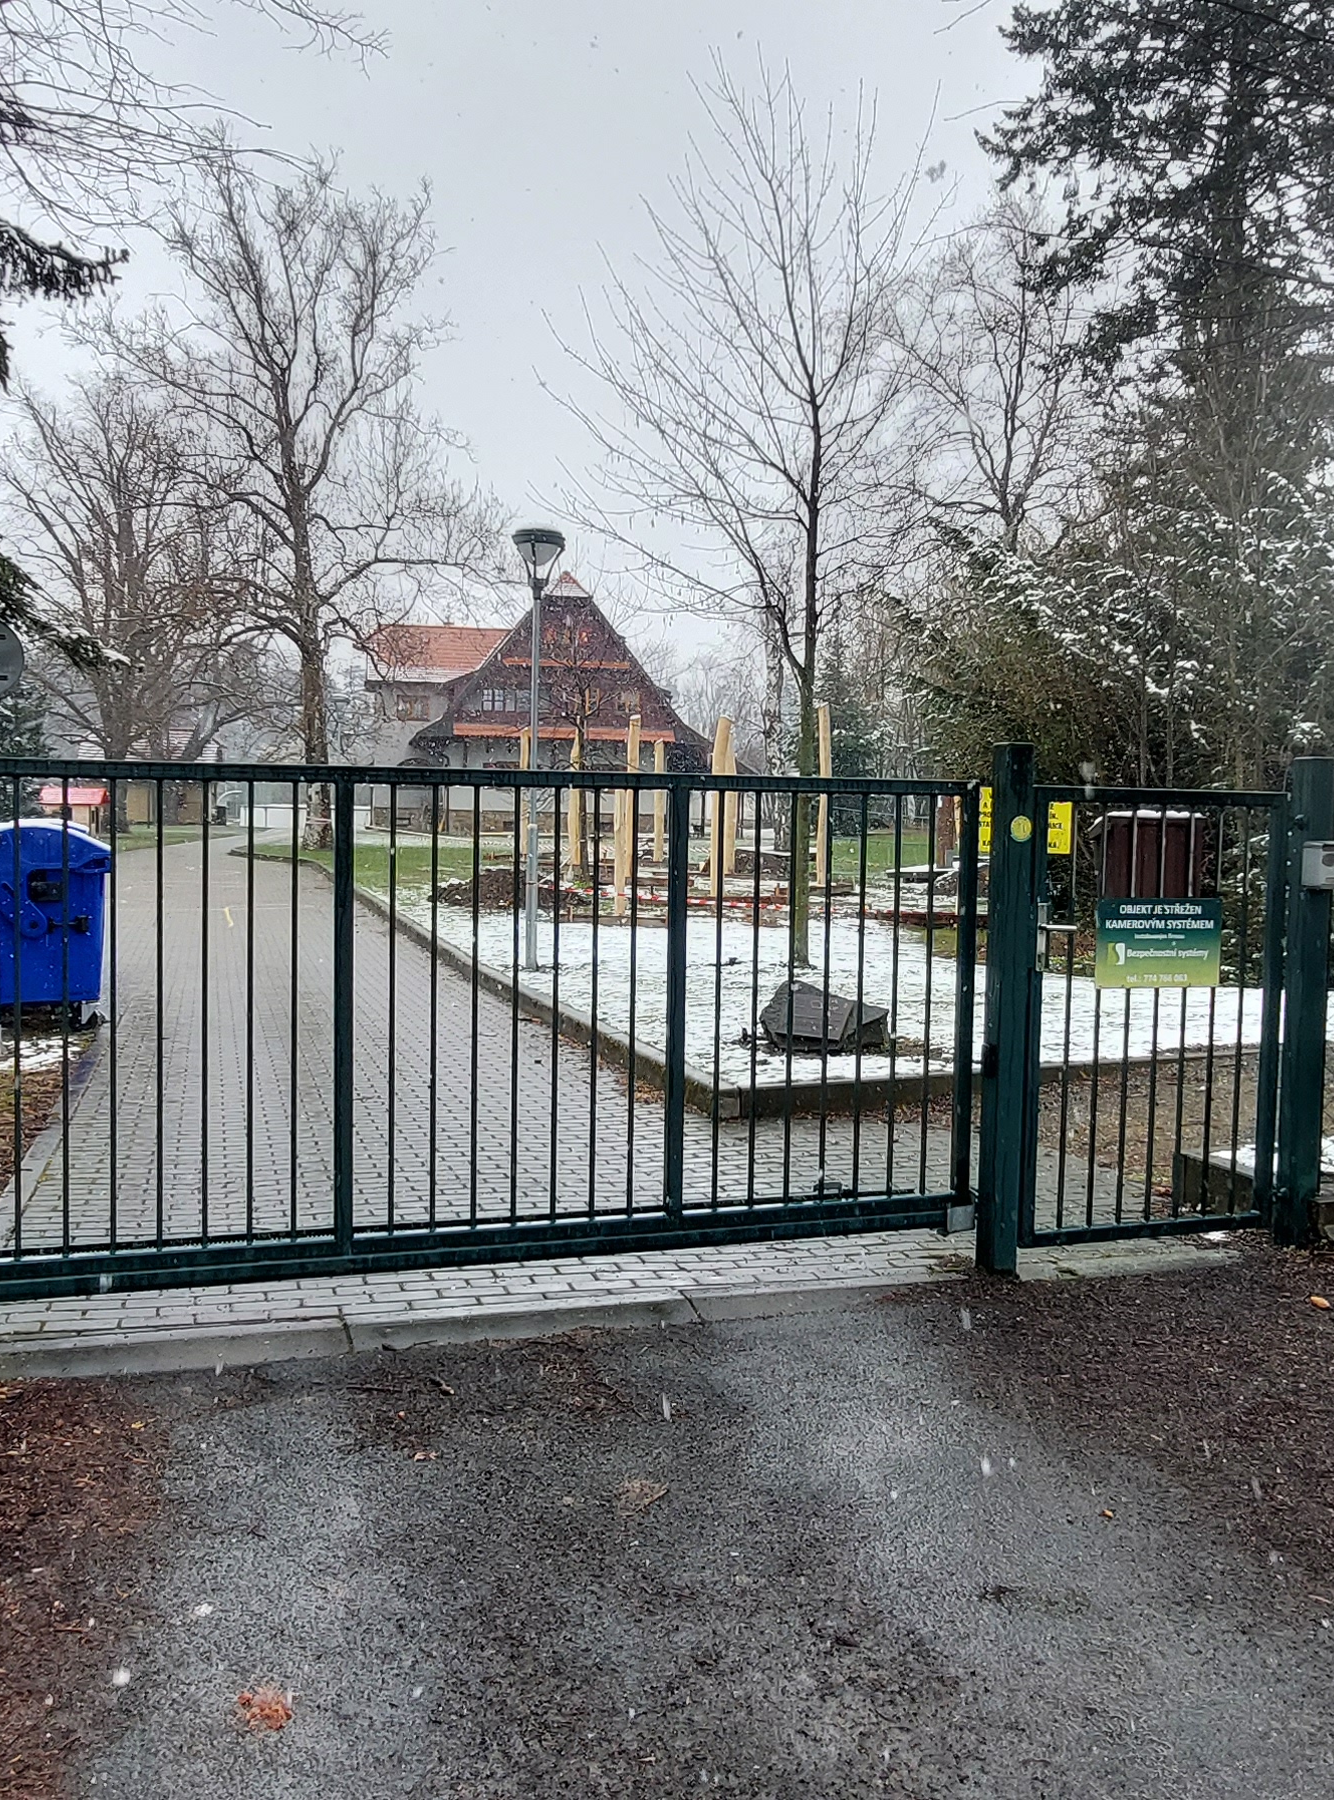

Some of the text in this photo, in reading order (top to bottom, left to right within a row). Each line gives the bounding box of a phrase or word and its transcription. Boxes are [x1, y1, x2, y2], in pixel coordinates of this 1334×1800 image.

[1119, 902, 1202, 915] OBJEKT JE STŘEŽEN
[1105, 917, 1214, 929] KAMEROVÝM SYSTÉMEM
